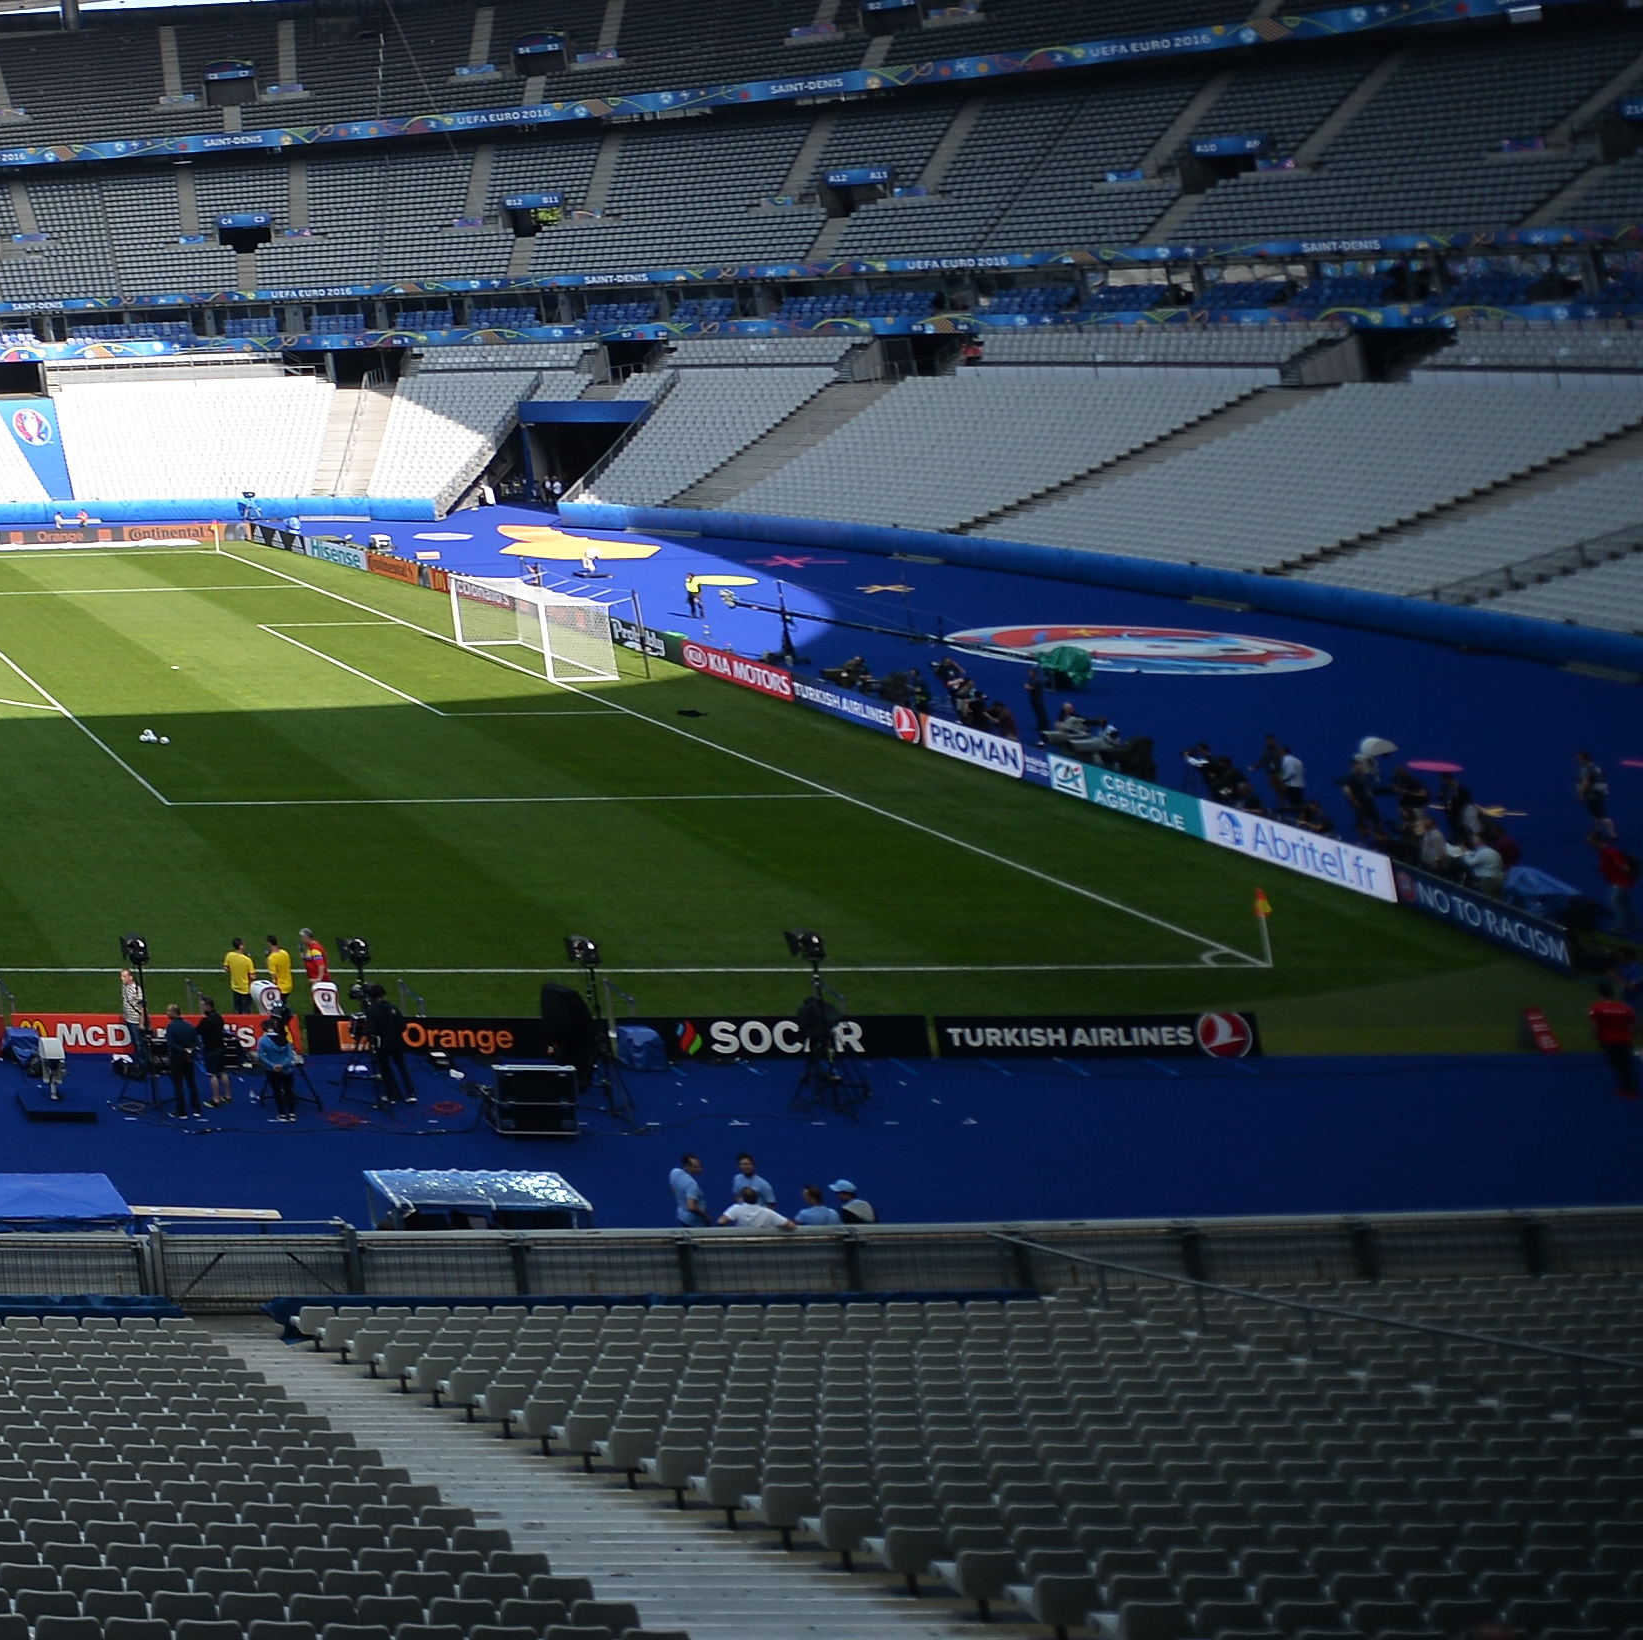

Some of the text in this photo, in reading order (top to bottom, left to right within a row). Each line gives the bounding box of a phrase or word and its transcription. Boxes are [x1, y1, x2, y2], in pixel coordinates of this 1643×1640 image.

[1090, 34, 1211, 58] UEFA EURO 2016
[769, 78, 844, 94] SAINT-DENIS
[456, 108, 551, 125] UEFA EURO 2016
[1, 152, 26, 162] 2016
[906, 256, 1009, 270] UEFA EURO 2016
[311, 540, 361, 568] Hisense
[707, 652, 791, 695] KIA MOTORS
[792, 682, 893, 728] TURKISH AIRLINES
[929, 723, 1020, 771] PROMAN
[1099, 775, 1167, 806] CRÉDIT
[1094, 790, 1187, 832] AGRICOLE
[1254, 823, 1376, 890] Abritel.fr
[1417, 882, 1571, 966] NO TO RACISM
[402, 1021, 514, 1055] Orange
[709, 1018, 866, 1054] SOCR
[946, 1024, 1194, 1049] TURKISH AIRLINES
